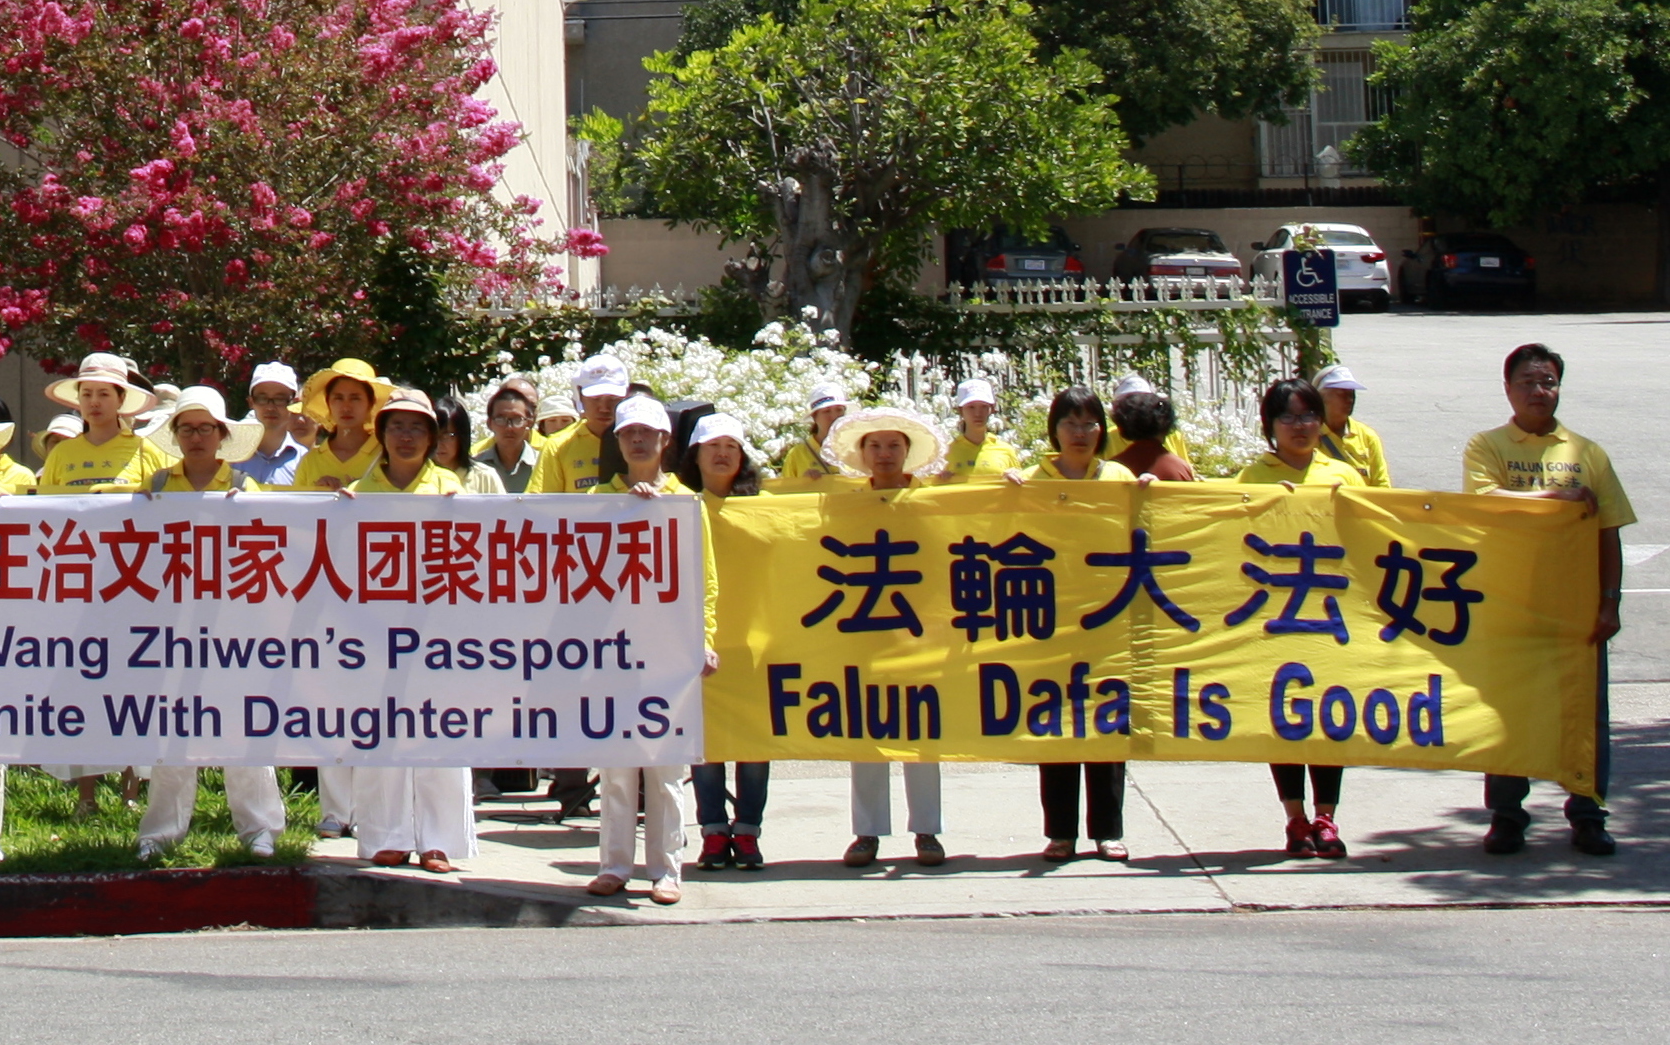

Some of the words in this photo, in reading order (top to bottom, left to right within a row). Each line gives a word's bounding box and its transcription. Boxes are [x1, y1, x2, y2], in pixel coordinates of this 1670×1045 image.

[1299, 308, 1333, 319] TRANCE
[1507, 460, 1543, 471] FALUN
[1546, 461, 1581, 472] GONG
[800, 528, 1484, 646] 法輪大法好
[388, 626, 645, 681] Passport.
[103, 694, 222, 737] With
[243, 695, 493, 749] Daughter
[511, 697, 557, 738] in
[579, 696, 684, 739] U.S.
[767, 663, 941, 741] Falun
[980, 660, 1131, 738] Dafa
[1174, 667, 1232, 740] Is
[1269, 661, 1445, 748] Good
